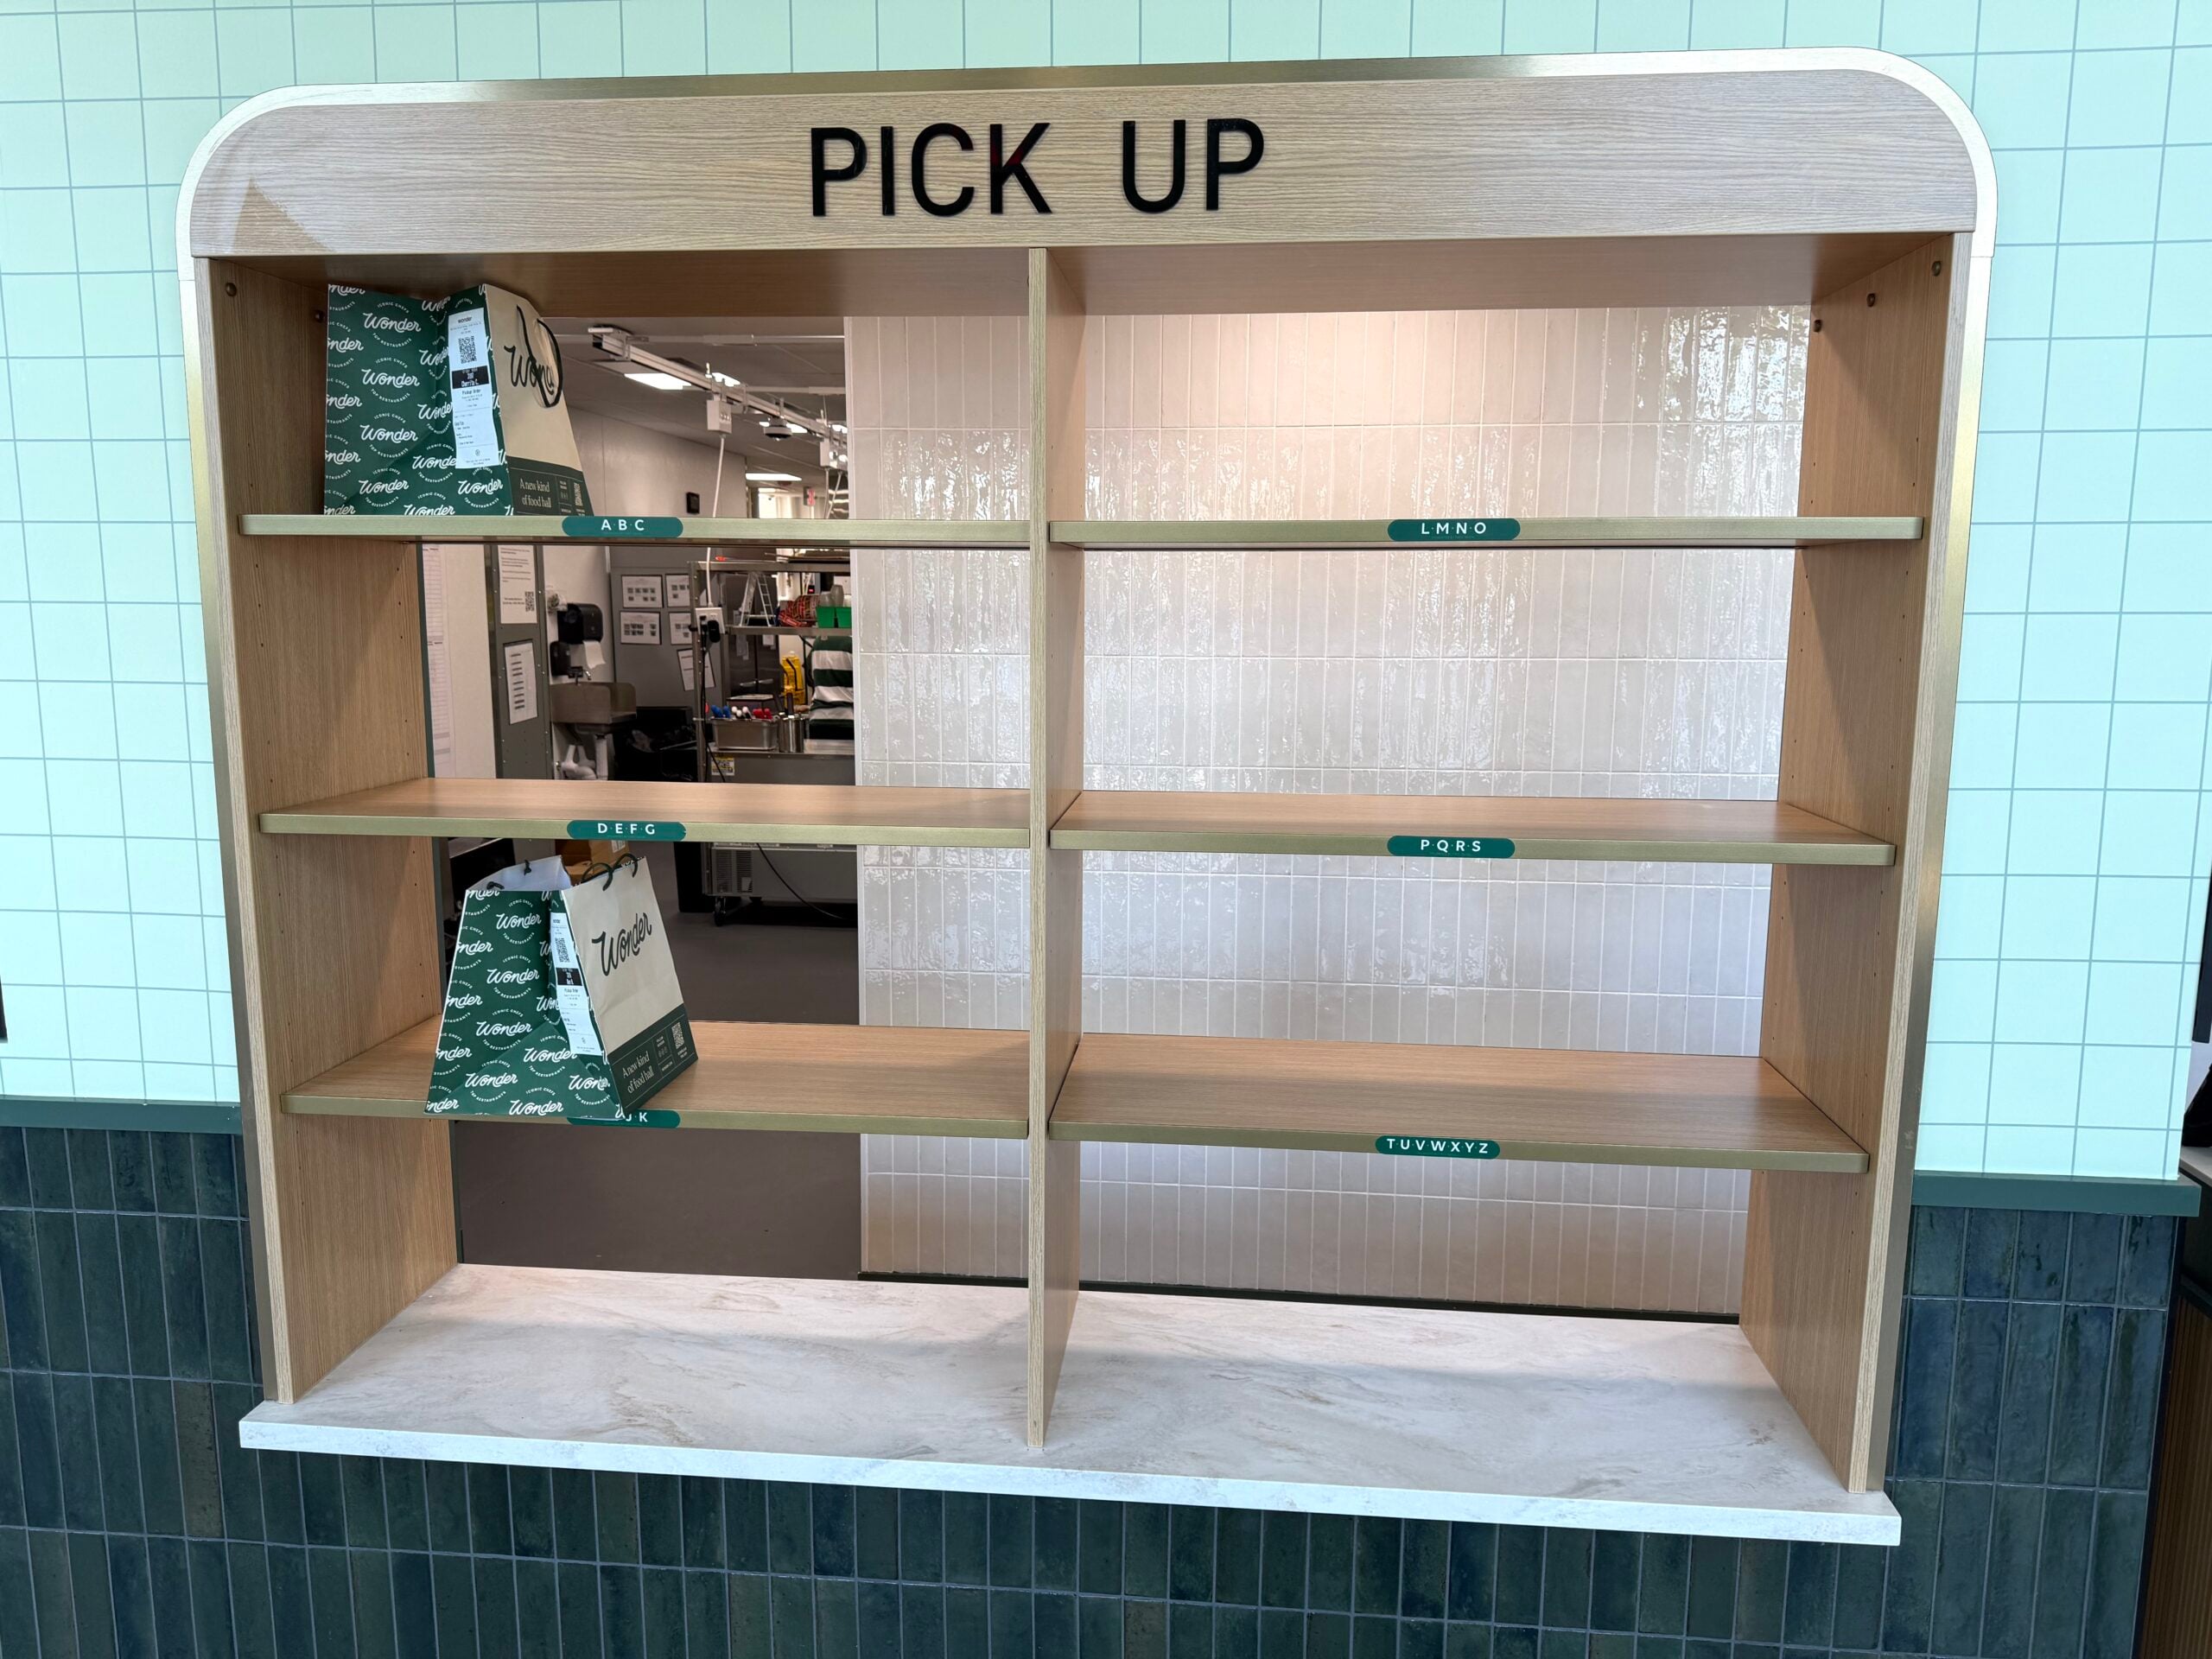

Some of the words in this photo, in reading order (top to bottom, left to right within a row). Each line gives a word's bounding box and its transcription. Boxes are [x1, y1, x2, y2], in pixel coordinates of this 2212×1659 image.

[810, 123, 1052, 216] PICK
[1123, 118, 1264, 214] UP
[362, 312, 422, 334] Wonder
[361, 369, 420, 389] Wonder
[359, 424, 418, 444] Wonder
[412, 454, 456, 469] Wonde
[358, 479, 410, 495] Wonder
[458, 478, 504, 495] Wonder
[519, 478, 525, 489] A
[525, 482, 536, 491] new
[536, 480, 550, 493] kind
[522, 494, 529, 505] of
[528, 494, 542, 506] food
[541, 496, 552, 508] hall
[404, 504, 455, 516] Wonder
[496, 912, 542, 930] Wonder
[592, 912, 652, 976] Wonder
[486, 968, 540, 985] Wonder
[475, 1020, 533, 1037] Wonder
[622, 1067, 629, 1078] A
[626, 1063, 638, 1076] new
[636, 1051, 650, 1068] kind
[465, 1072, 518, 1088] Wonder
[627, 1080, 635, 1094] of
[632, 1071, 645, 1089] food
[644, 1065, 655, 1083] hall
[509, 1099, 563, 1116] Wonder
